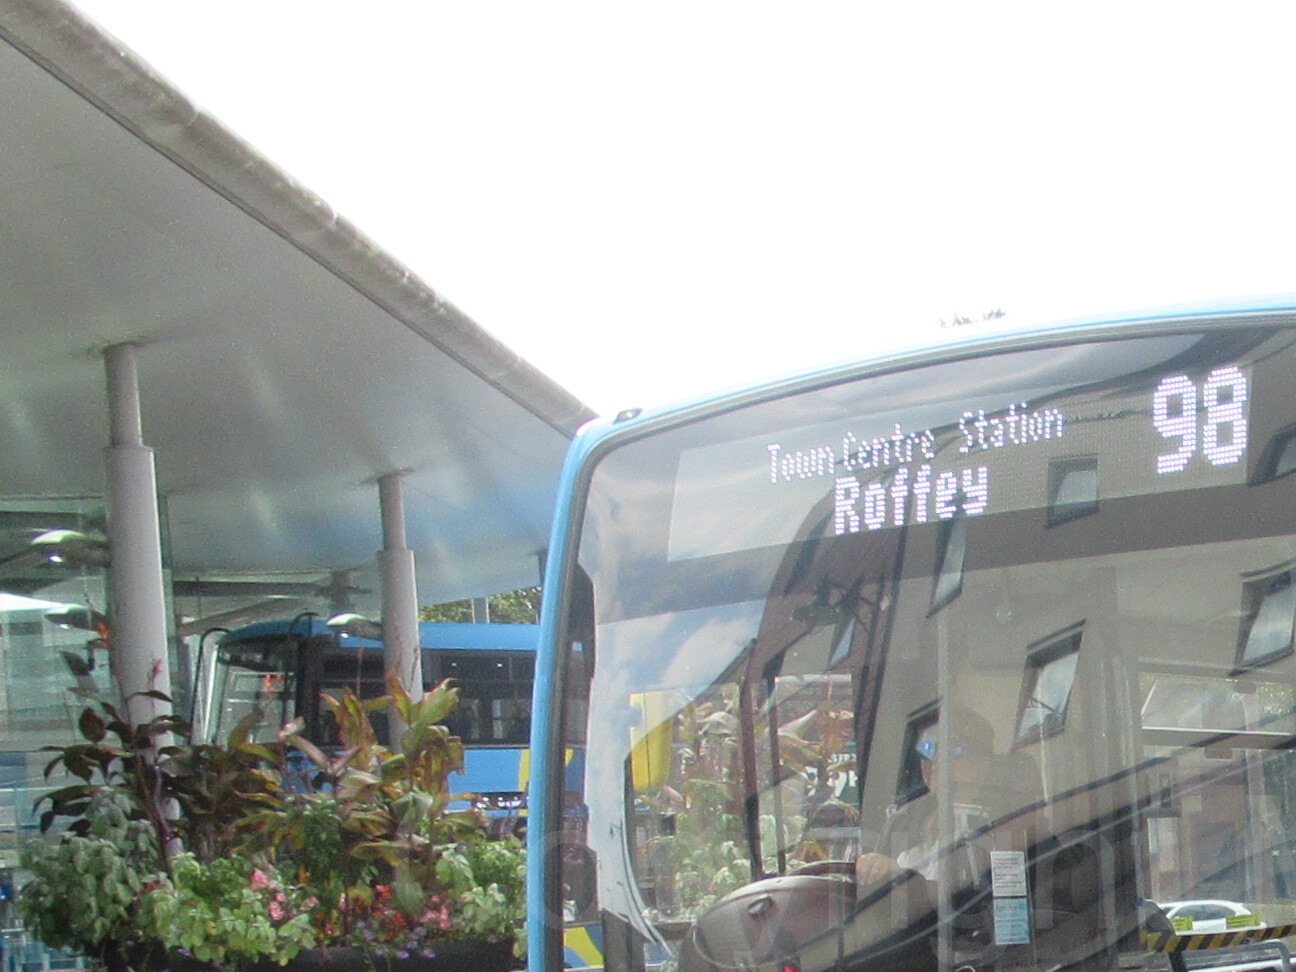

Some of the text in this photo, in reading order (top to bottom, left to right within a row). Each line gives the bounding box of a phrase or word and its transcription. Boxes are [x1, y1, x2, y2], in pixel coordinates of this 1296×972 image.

[767, 401, 1064, 484] Town Centre Station
[1152, 366, 1248, 475] 98
[834, 463, 989, 536] Roffey
